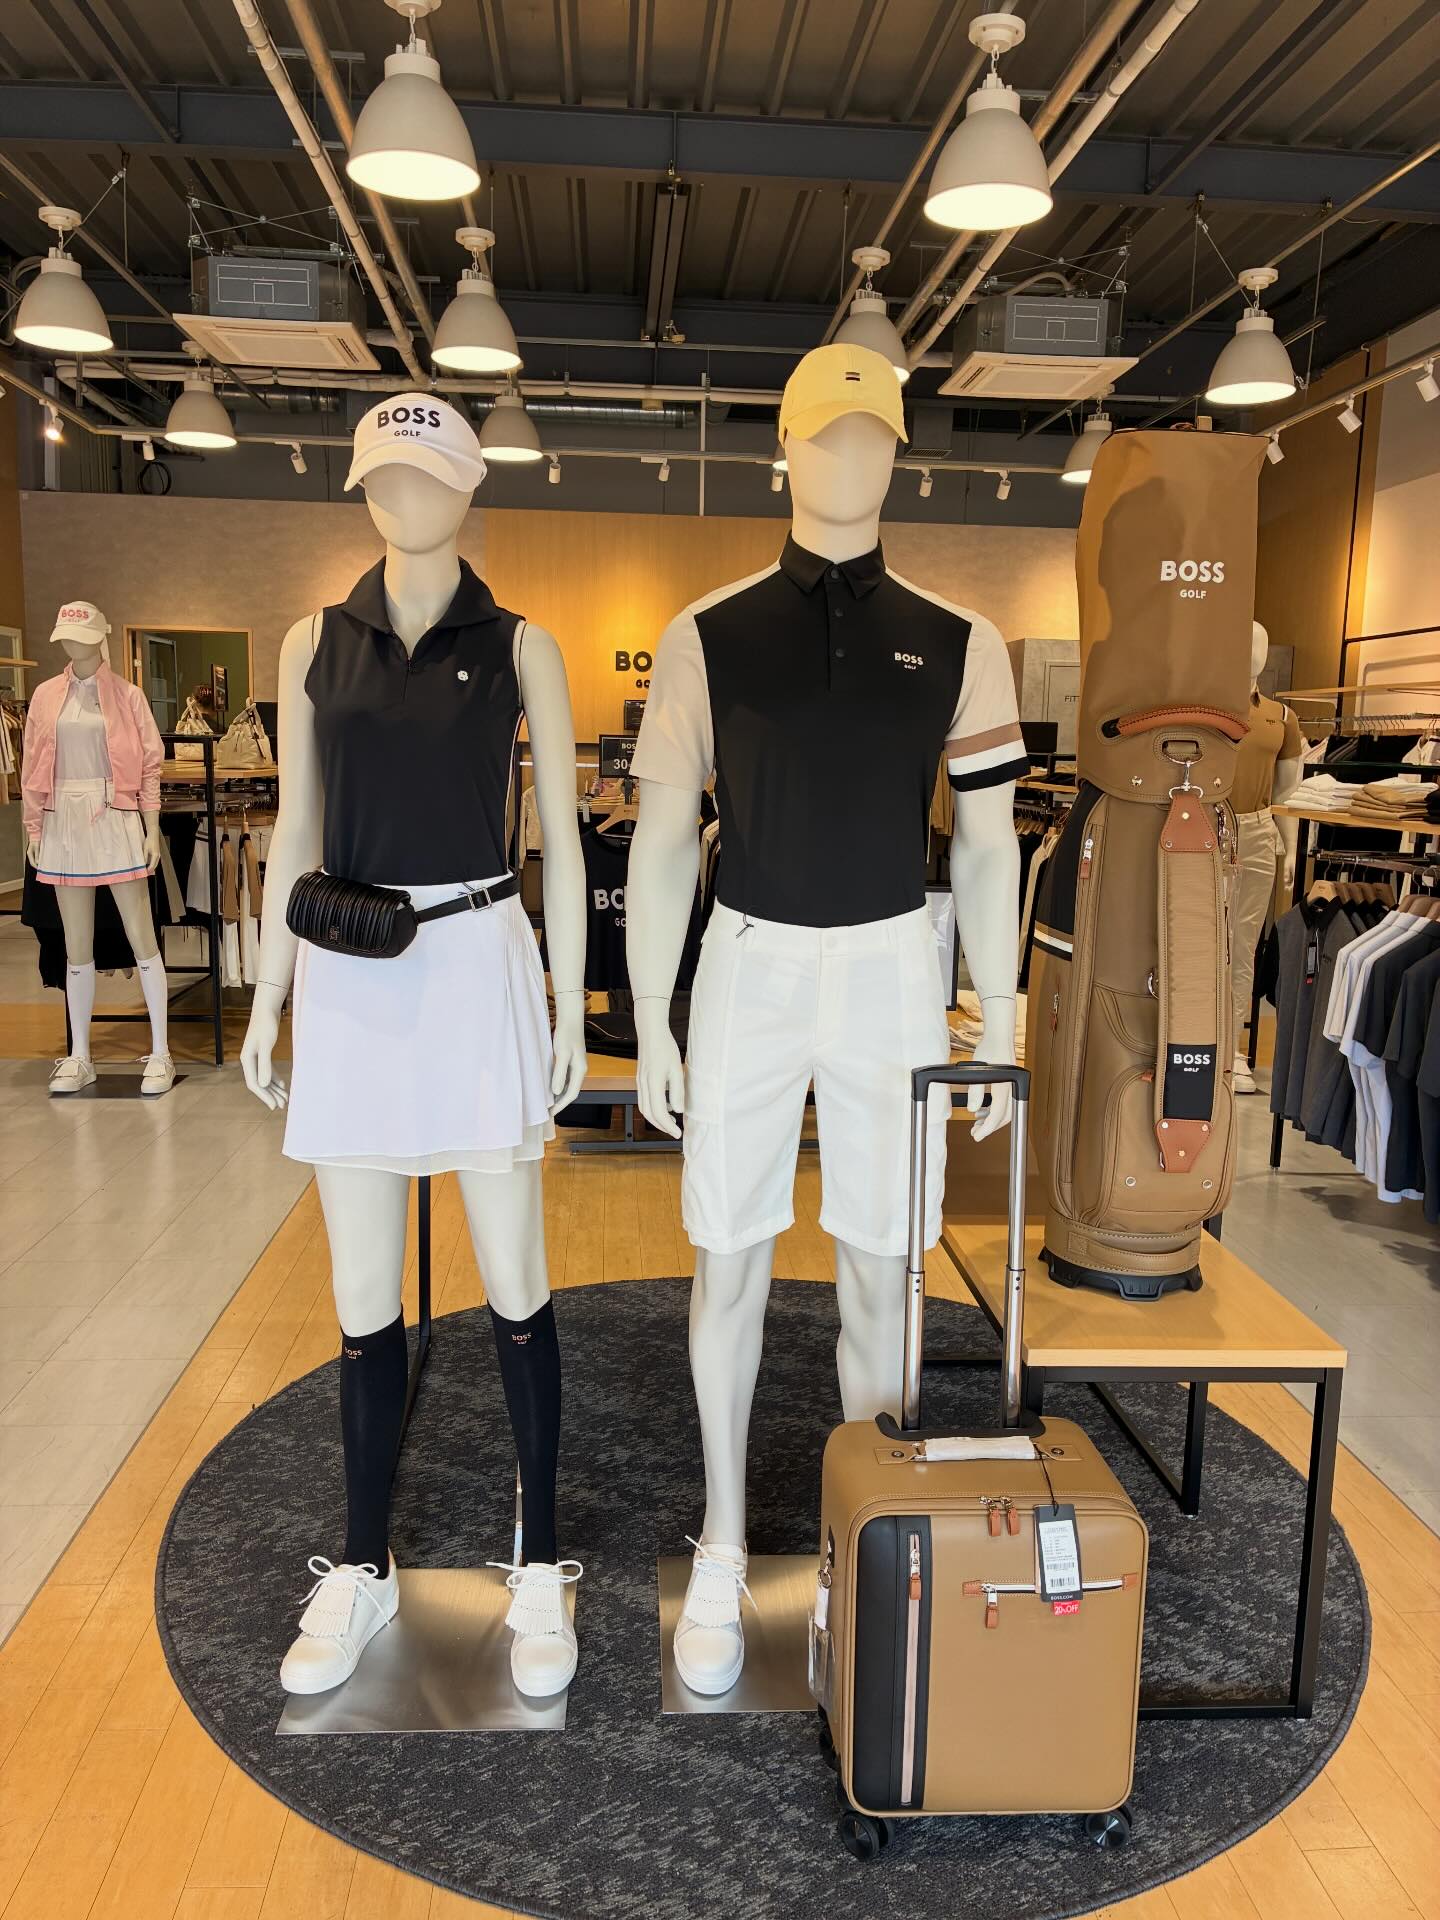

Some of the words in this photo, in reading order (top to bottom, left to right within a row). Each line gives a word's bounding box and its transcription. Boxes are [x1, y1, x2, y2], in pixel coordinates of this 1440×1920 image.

[377, 407, 441, 429] BOSS
[393, 429, 421, 437] GOLF
[1161, 560, 1225, 584] BOSS
[1179, 589, 1206, 599] GOLF
[61, 609, 89, 619] BOSS
[615, 650, 653, 673] BO
[894, 651, 924, 666] BOSS
[613, 758, 631, 770] 30
[1173, 1053, 1211, 1065] BOSS
